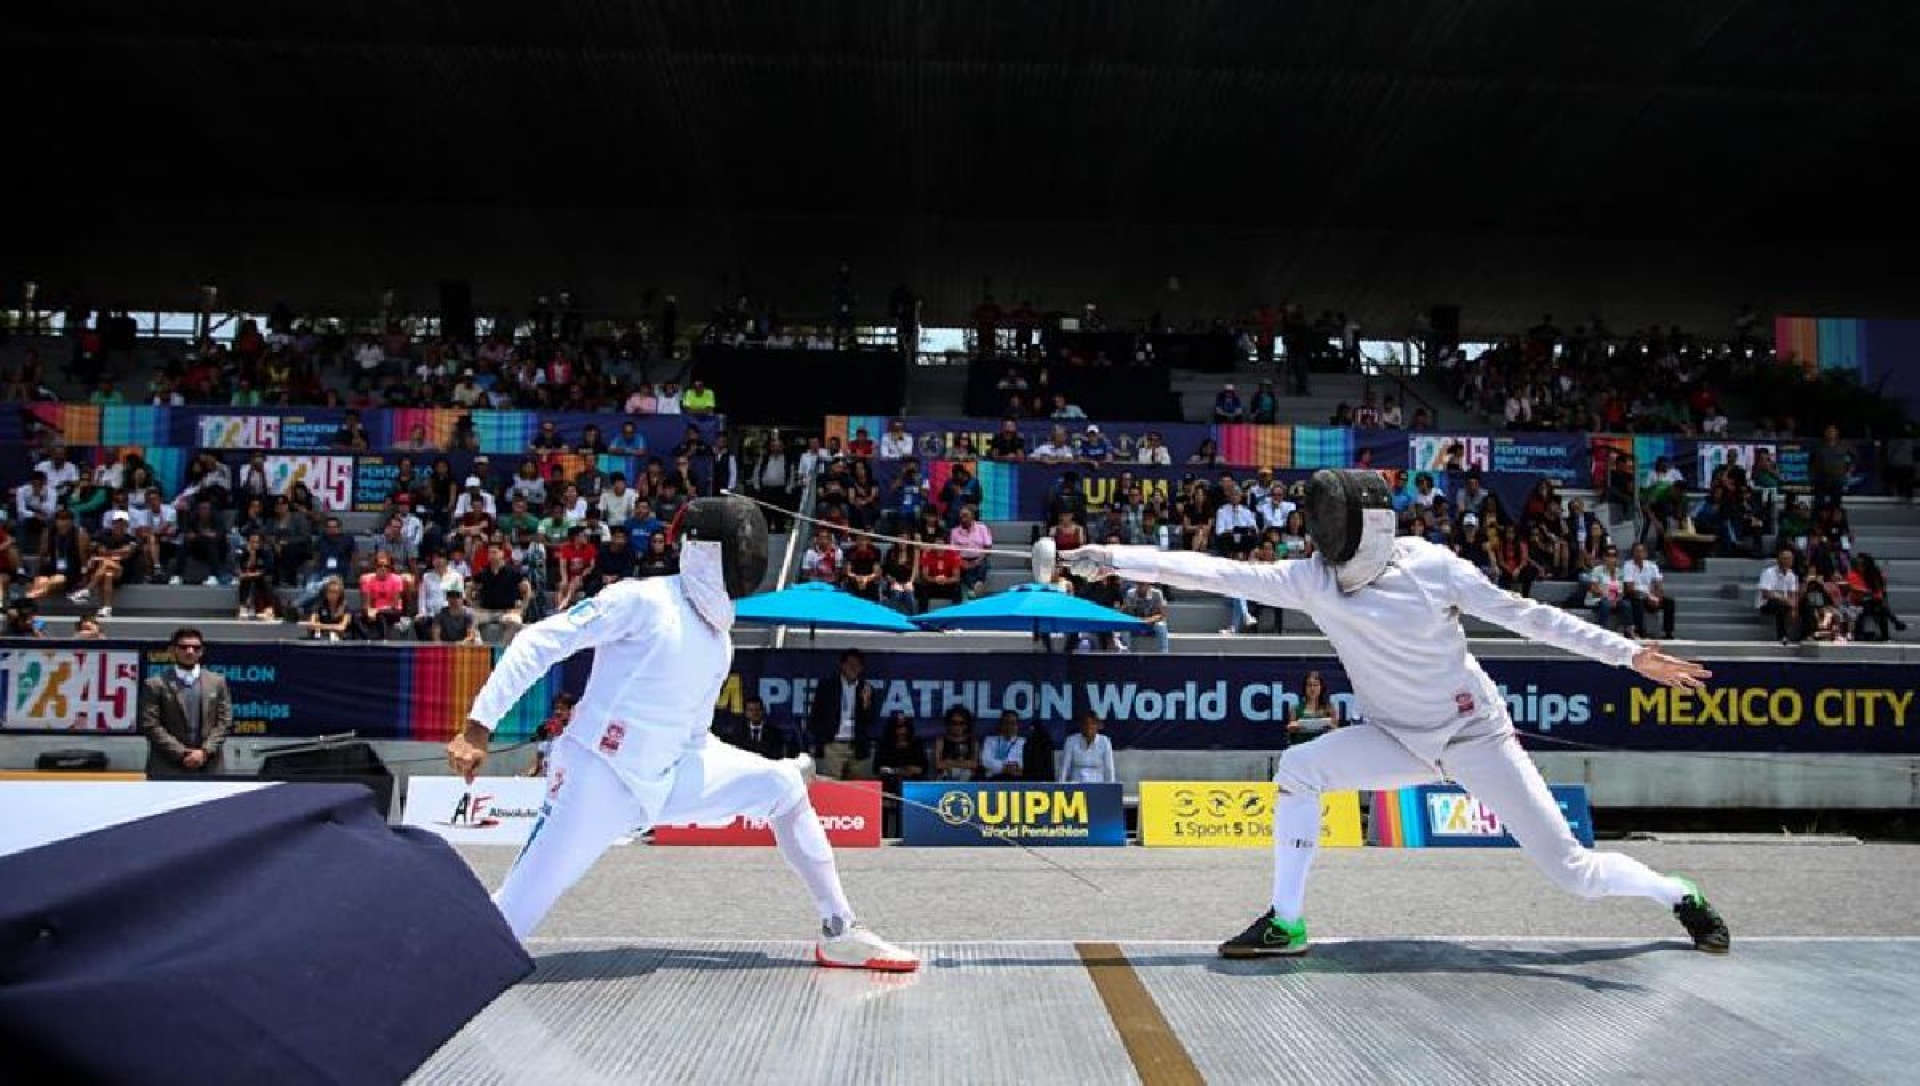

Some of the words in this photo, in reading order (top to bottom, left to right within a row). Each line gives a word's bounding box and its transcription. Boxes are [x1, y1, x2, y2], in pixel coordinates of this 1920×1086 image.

[759, 677, 1074, 721] PEATHLON
[1087, 680, 1228, 721] World
[1629, 687, 1801, 726] MEXICO
[1814, 690, 1913, 727] CITY
[978, 791, 1089, 825] UIPM
[817, 815, 865, 831] ance
[983, 825, 1019, 838] World
[1022, 825, 1089, 838] Pentathlon
[1175, 821, 1185, 835] 1
[1187, 821, 1230, 838] Sport
[1233, 821, 1244, 836] 5
